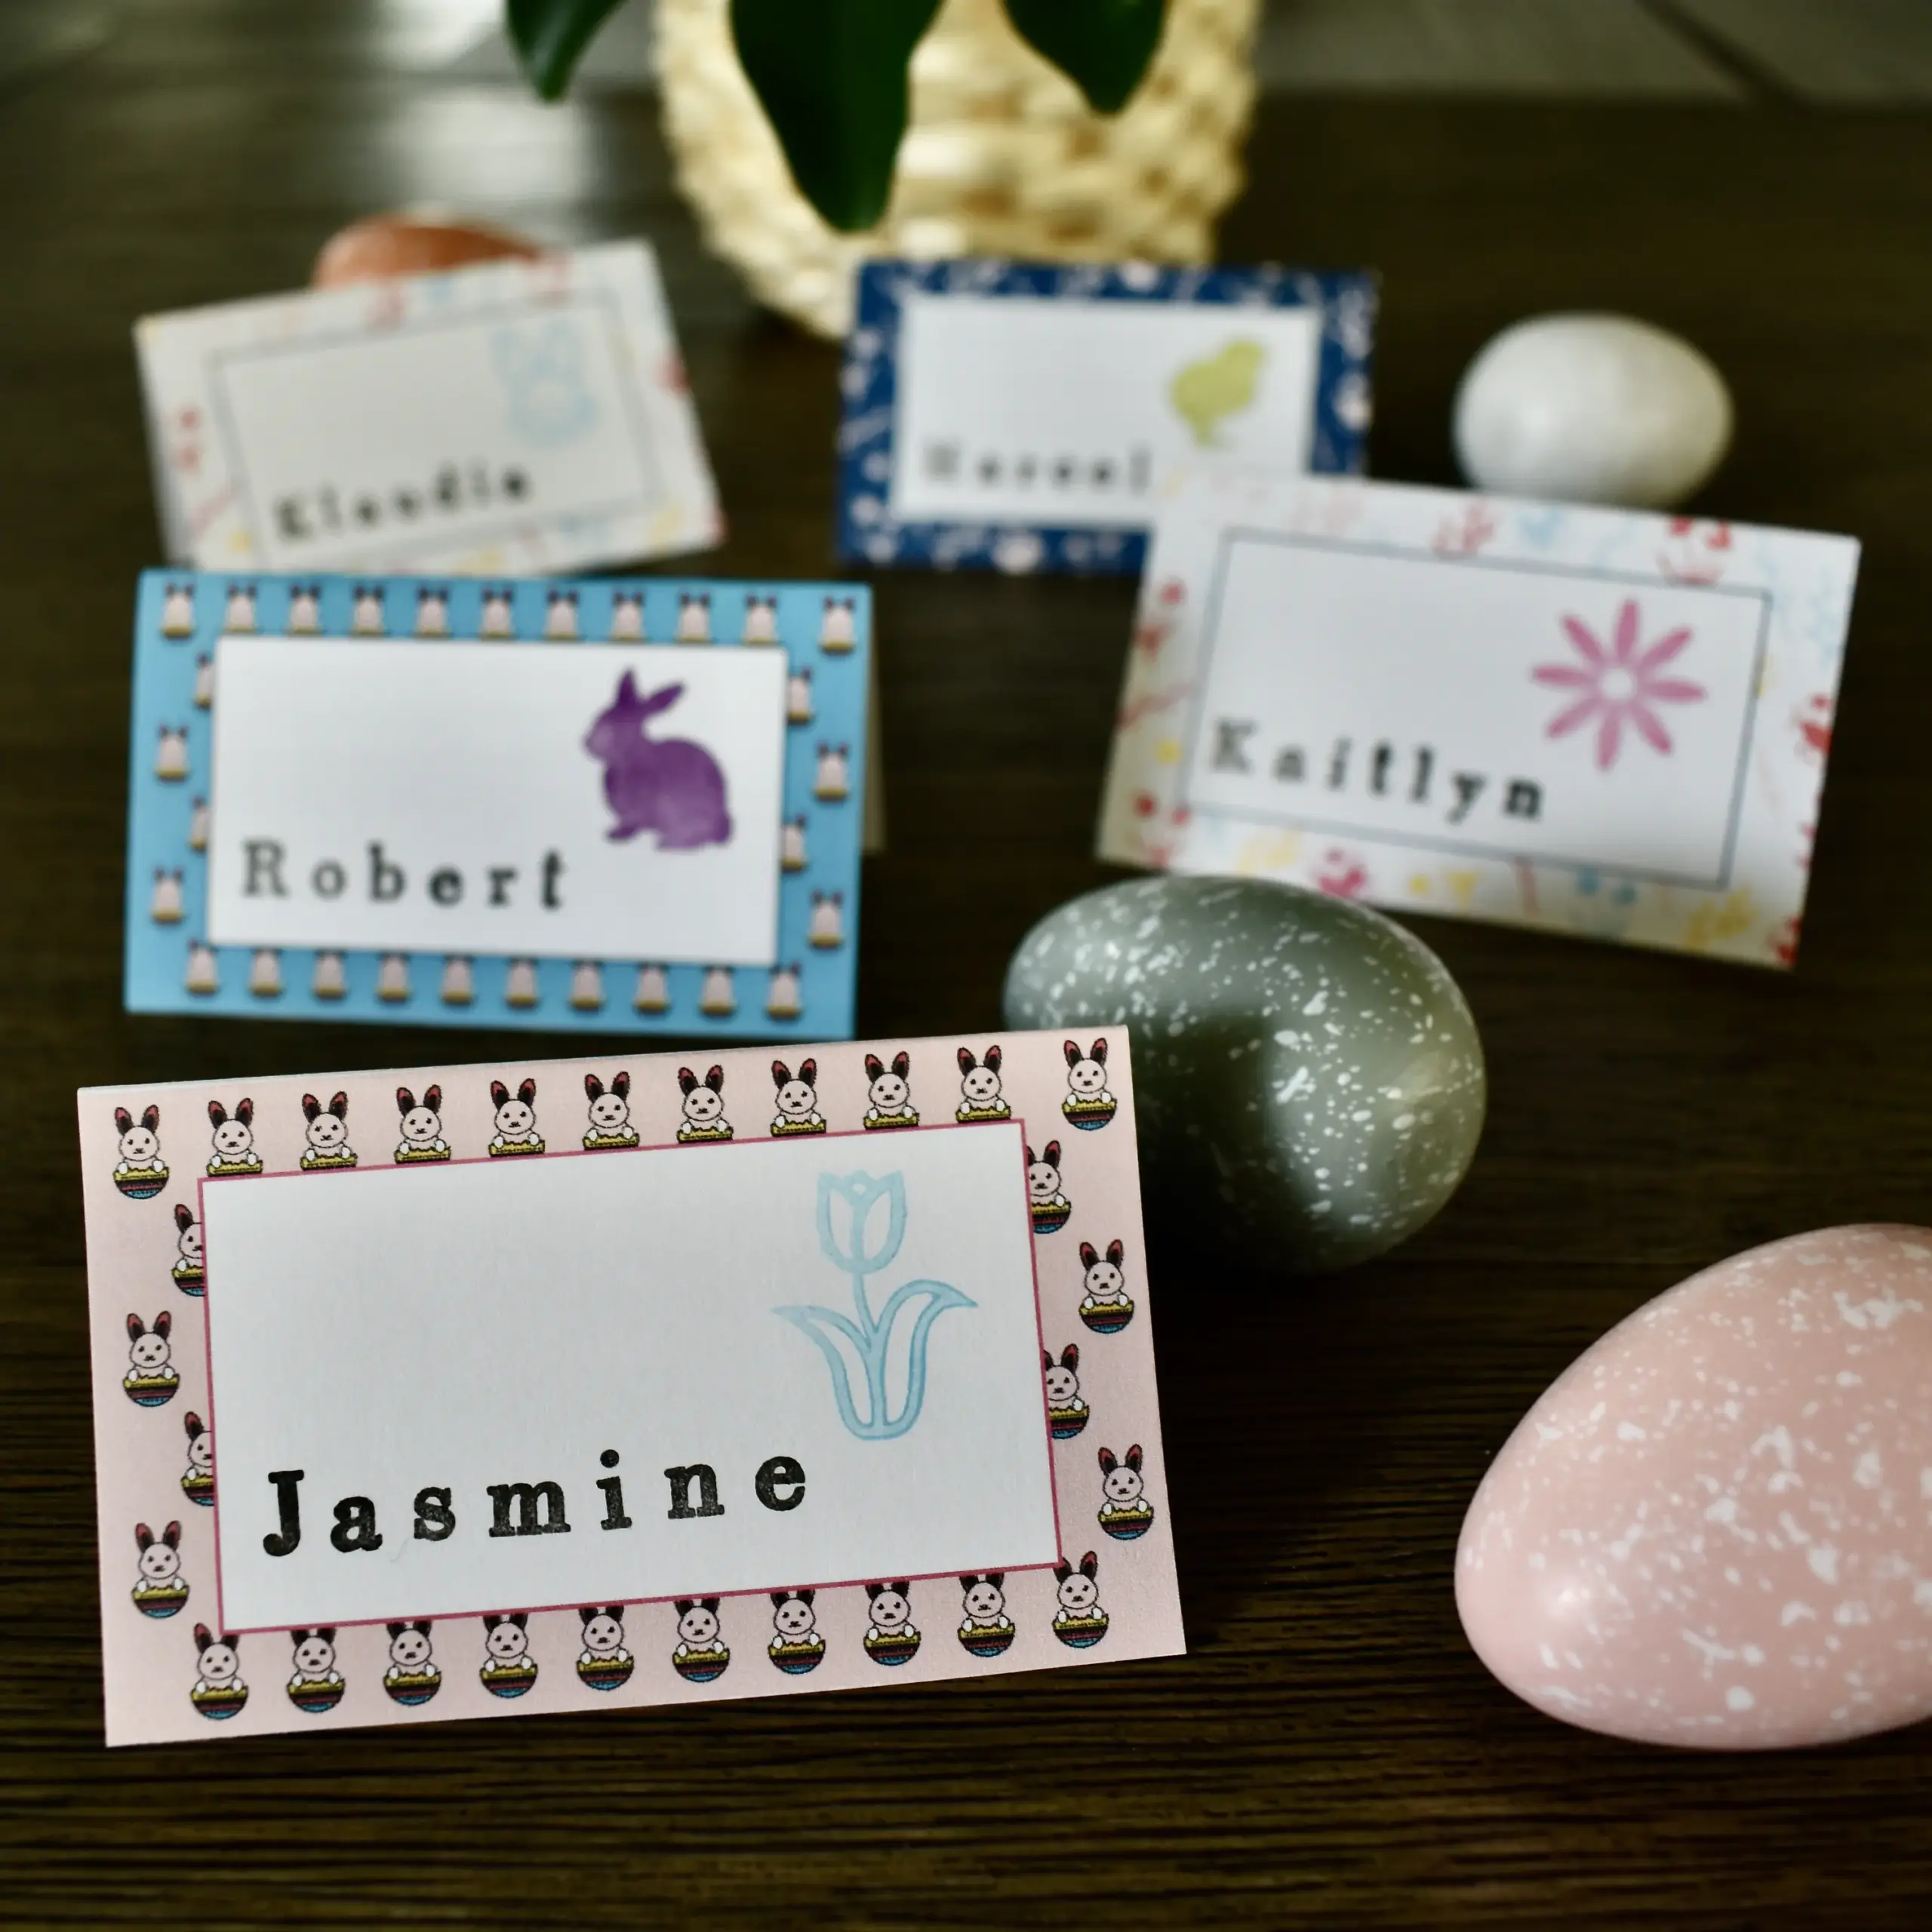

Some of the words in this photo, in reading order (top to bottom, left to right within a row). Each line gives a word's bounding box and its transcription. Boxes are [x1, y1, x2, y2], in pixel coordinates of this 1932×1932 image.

[1212, 717, 1544, 826] Kaitlyn
[243, 839, 565, 910] Robert
[263, 1449, 807, 1557] Jasmine
